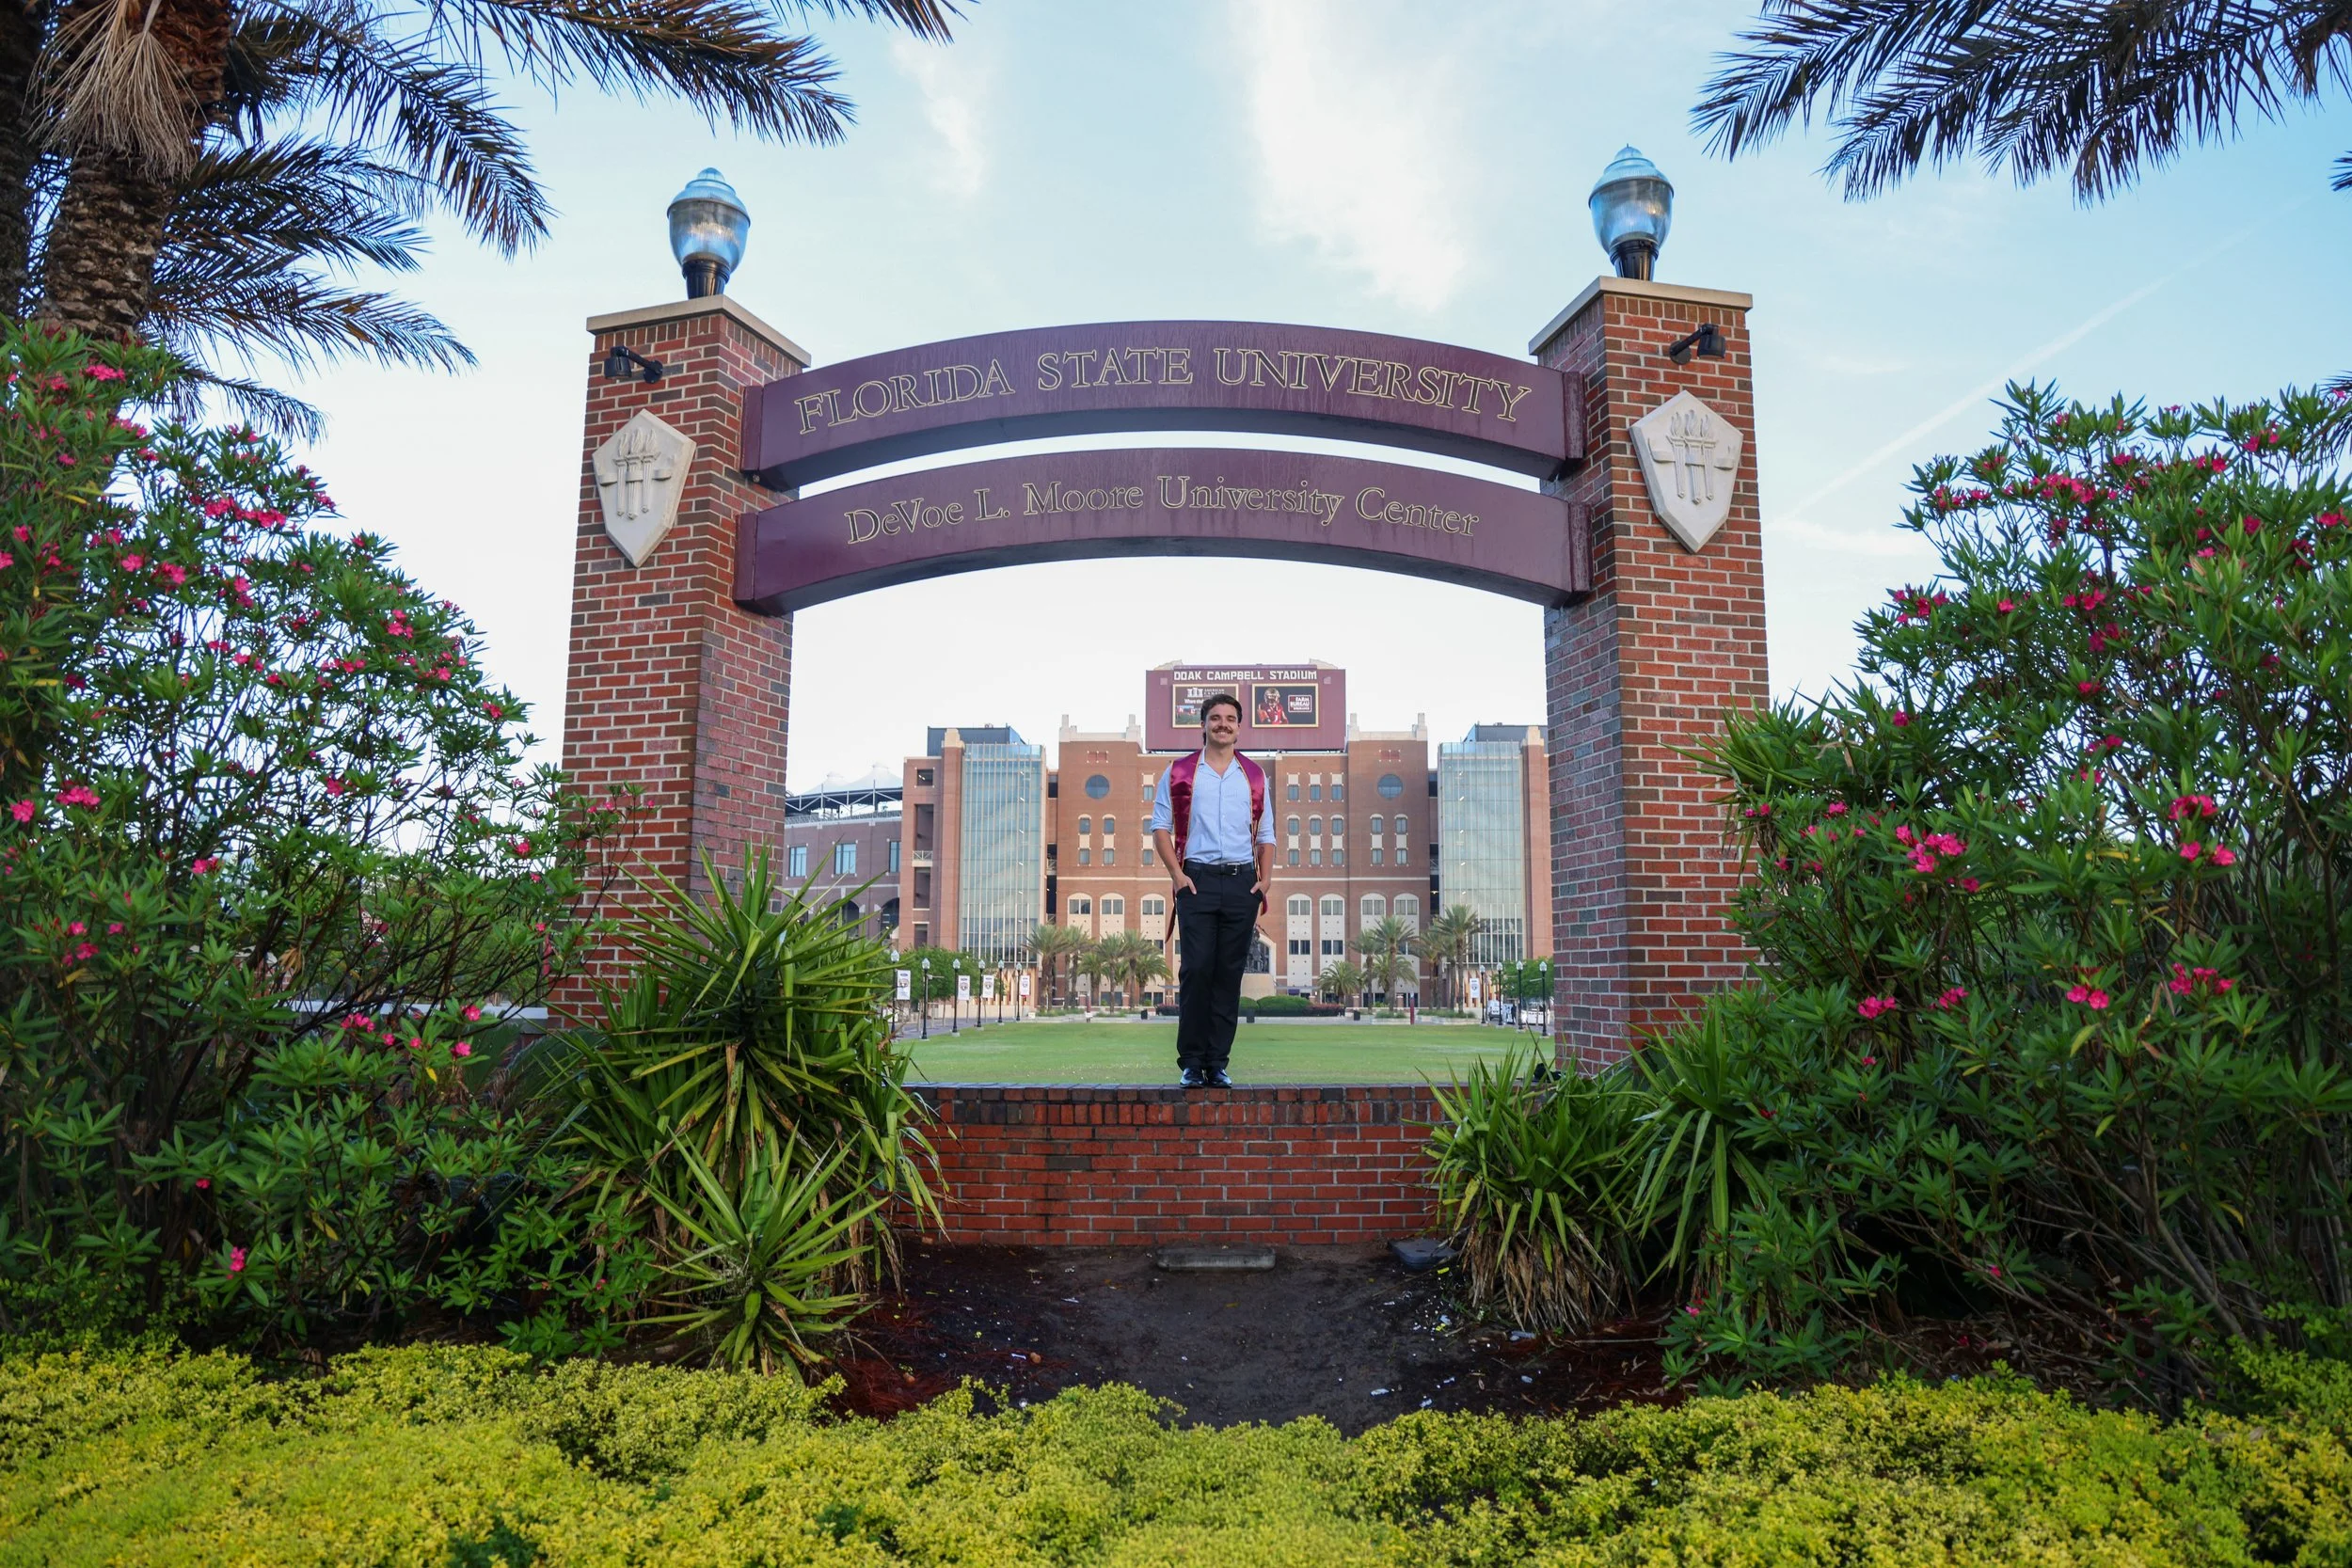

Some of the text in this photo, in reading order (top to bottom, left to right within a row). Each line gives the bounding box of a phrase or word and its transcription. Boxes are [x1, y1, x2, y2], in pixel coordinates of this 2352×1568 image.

[794, 346, 1532, 435] FLORIDA STATE UNIVERSITY
[844, 476, 1480, 545] DeVoe L. Moore University Center
[1173, 670, 1317, 680] DOAK CAMPBELL STADIUM
